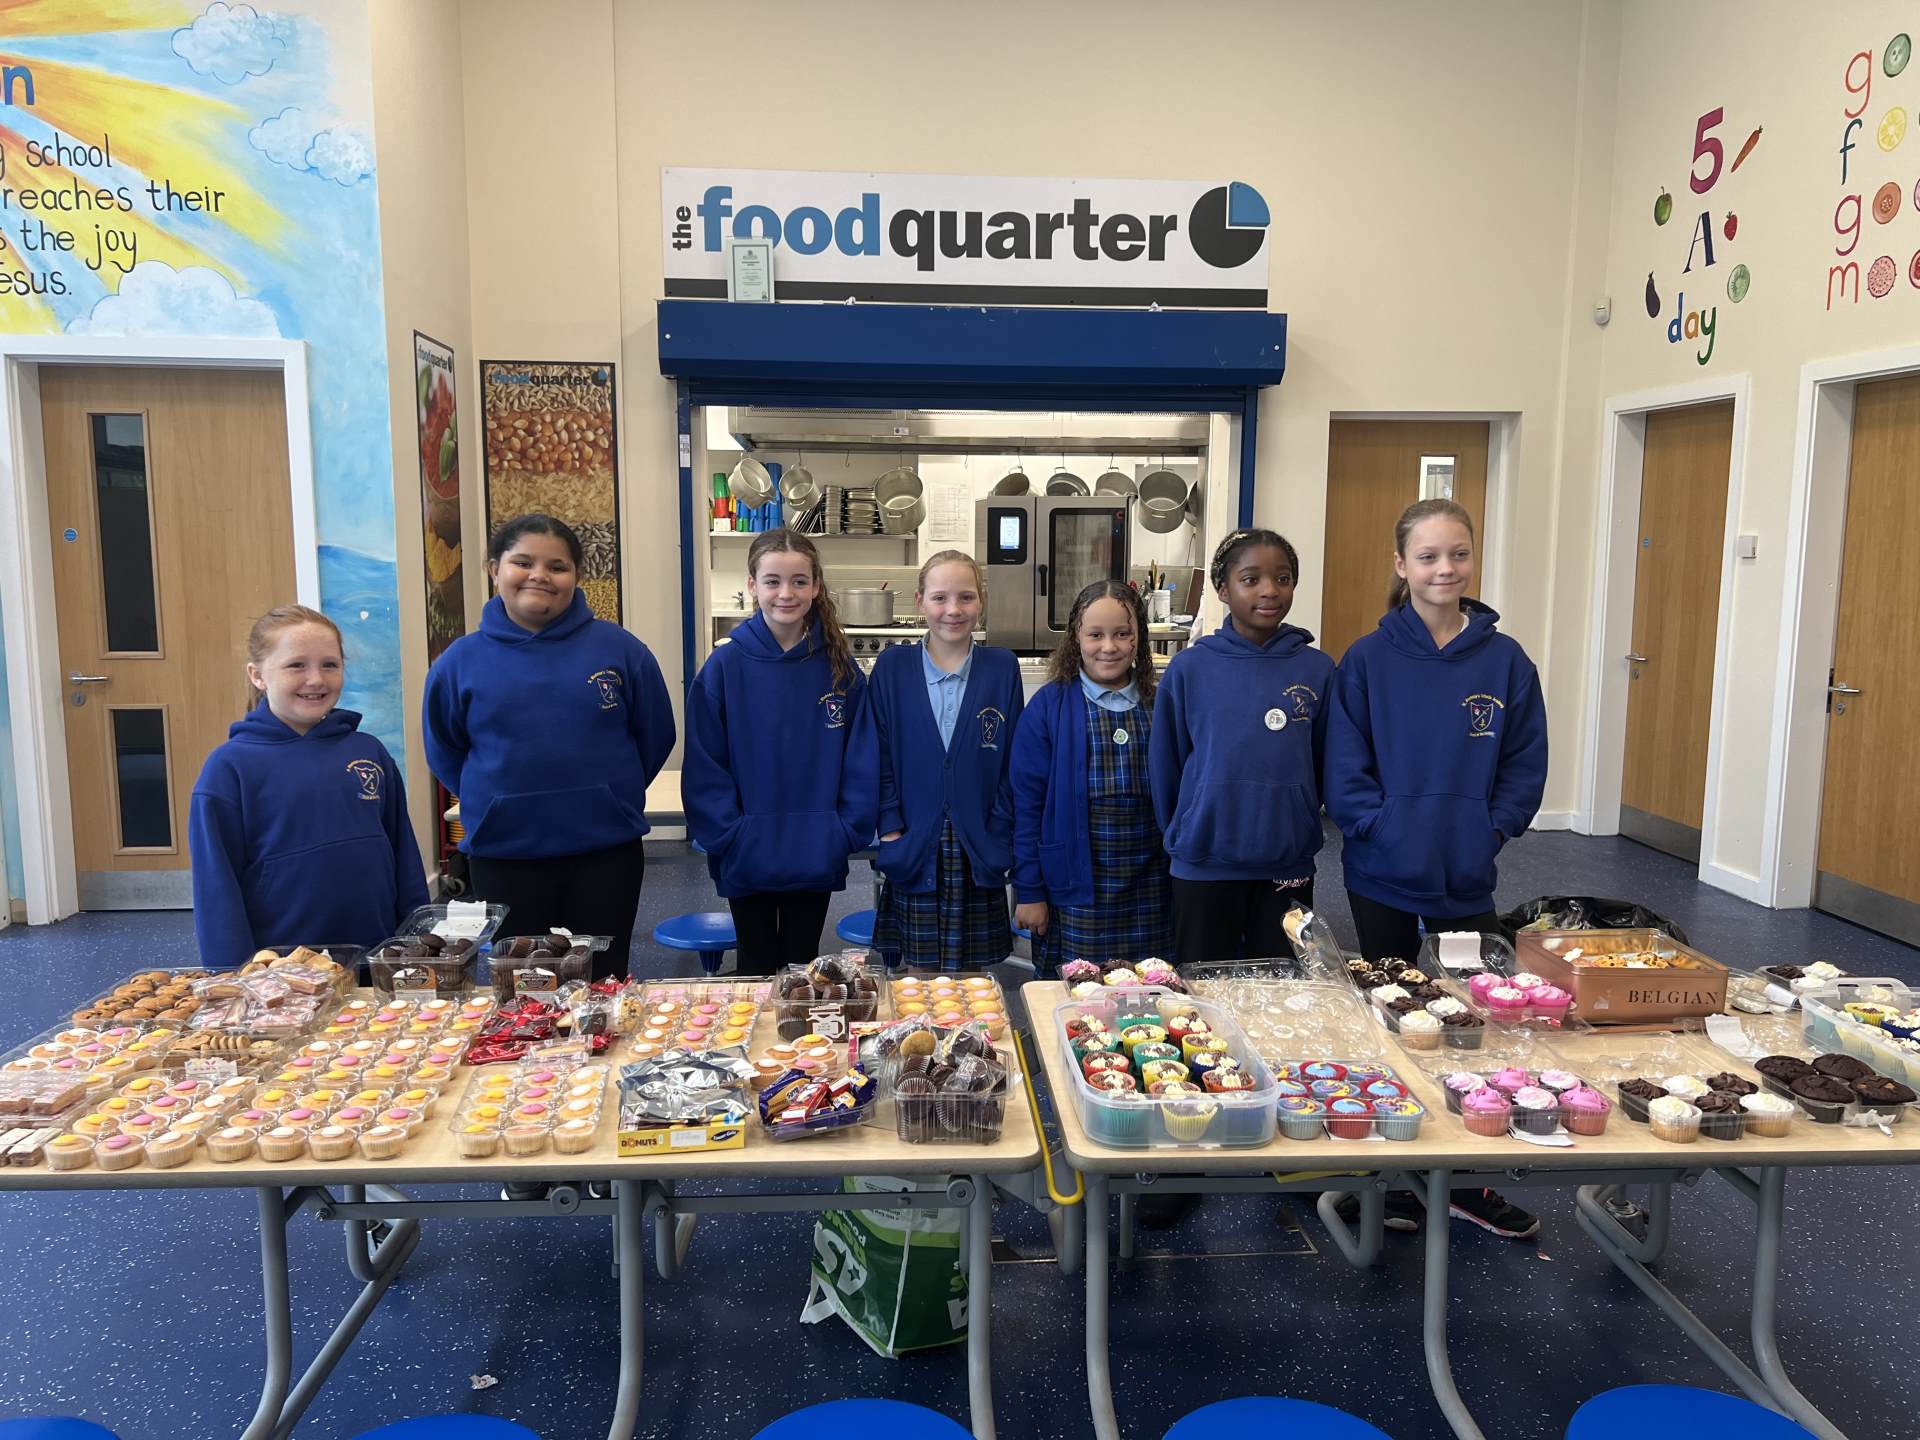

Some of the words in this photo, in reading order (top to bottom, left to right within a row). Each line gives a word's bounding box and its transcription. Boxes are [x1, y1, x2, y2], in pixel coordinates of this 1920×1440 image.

[26, 132, 112, 168] school
[1689, 106, 1724, 195] 5
[3, 177, 133, 212] reaches
[146, 179, 225, 213] their
[20, 219, 75, 251] the
[86, 223, 137, 273] joy
[672, 205, 692, 251] the
[1682, 211, 1716, 274] A
[0, 263, 72, 297] esus.
[1668, 292, 1717, 366] day
[1628, 989, 1719, 1005] BELGIAN
